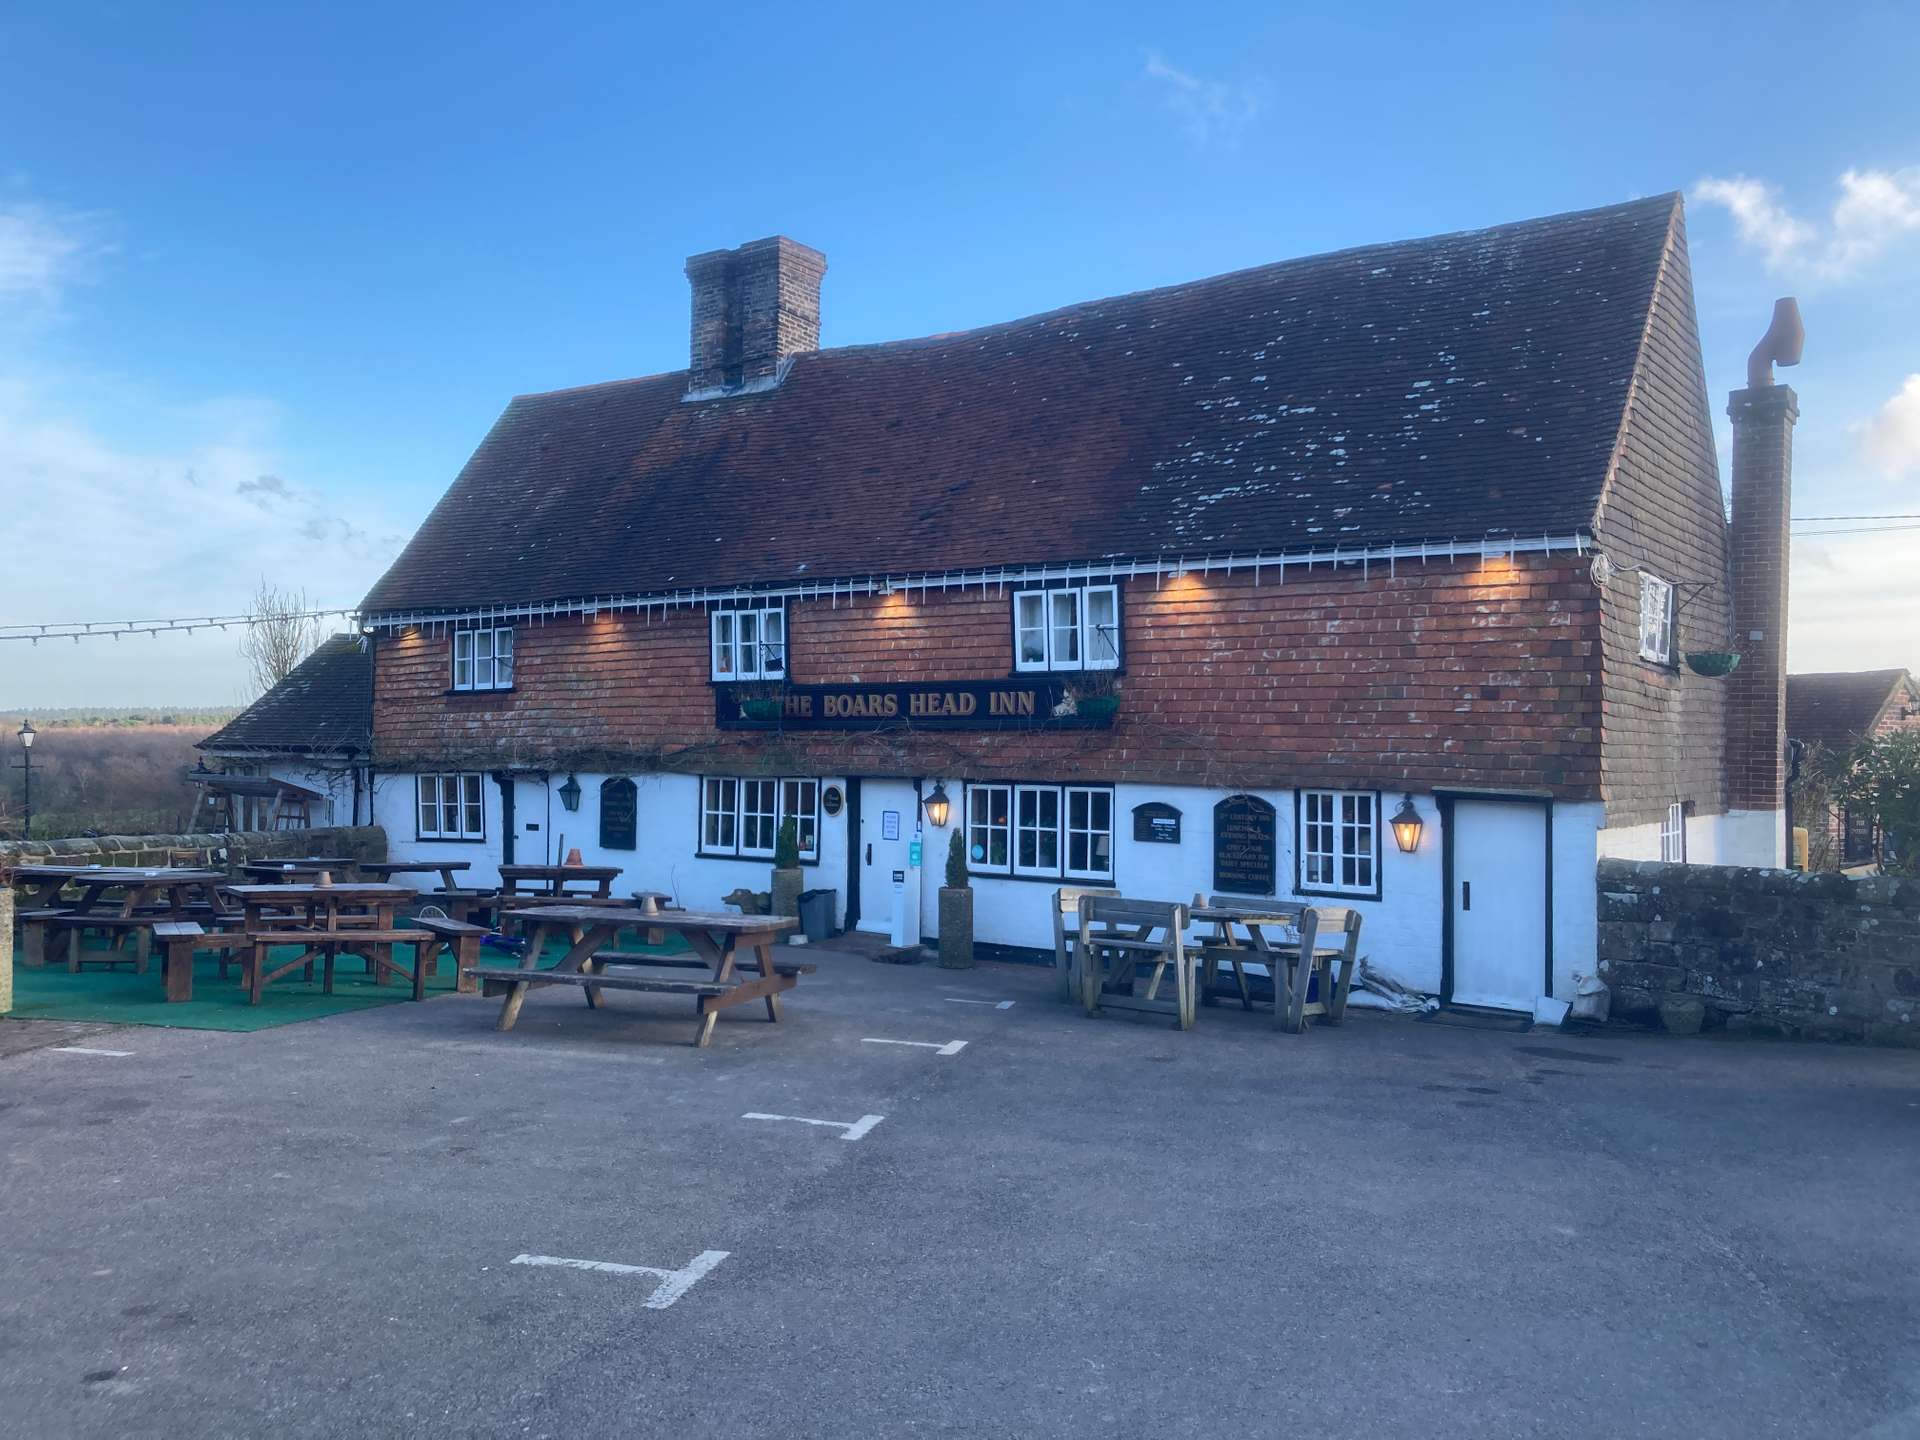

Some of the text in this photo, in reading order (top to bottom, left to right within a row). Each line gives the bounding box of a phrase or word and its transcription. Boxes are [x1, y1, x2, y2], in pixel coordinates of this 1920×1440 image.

[823, 694, 898, 717] BOARS
[909, 692, 977, 716] HEAD
[989, 691, 1036, 715] INN
